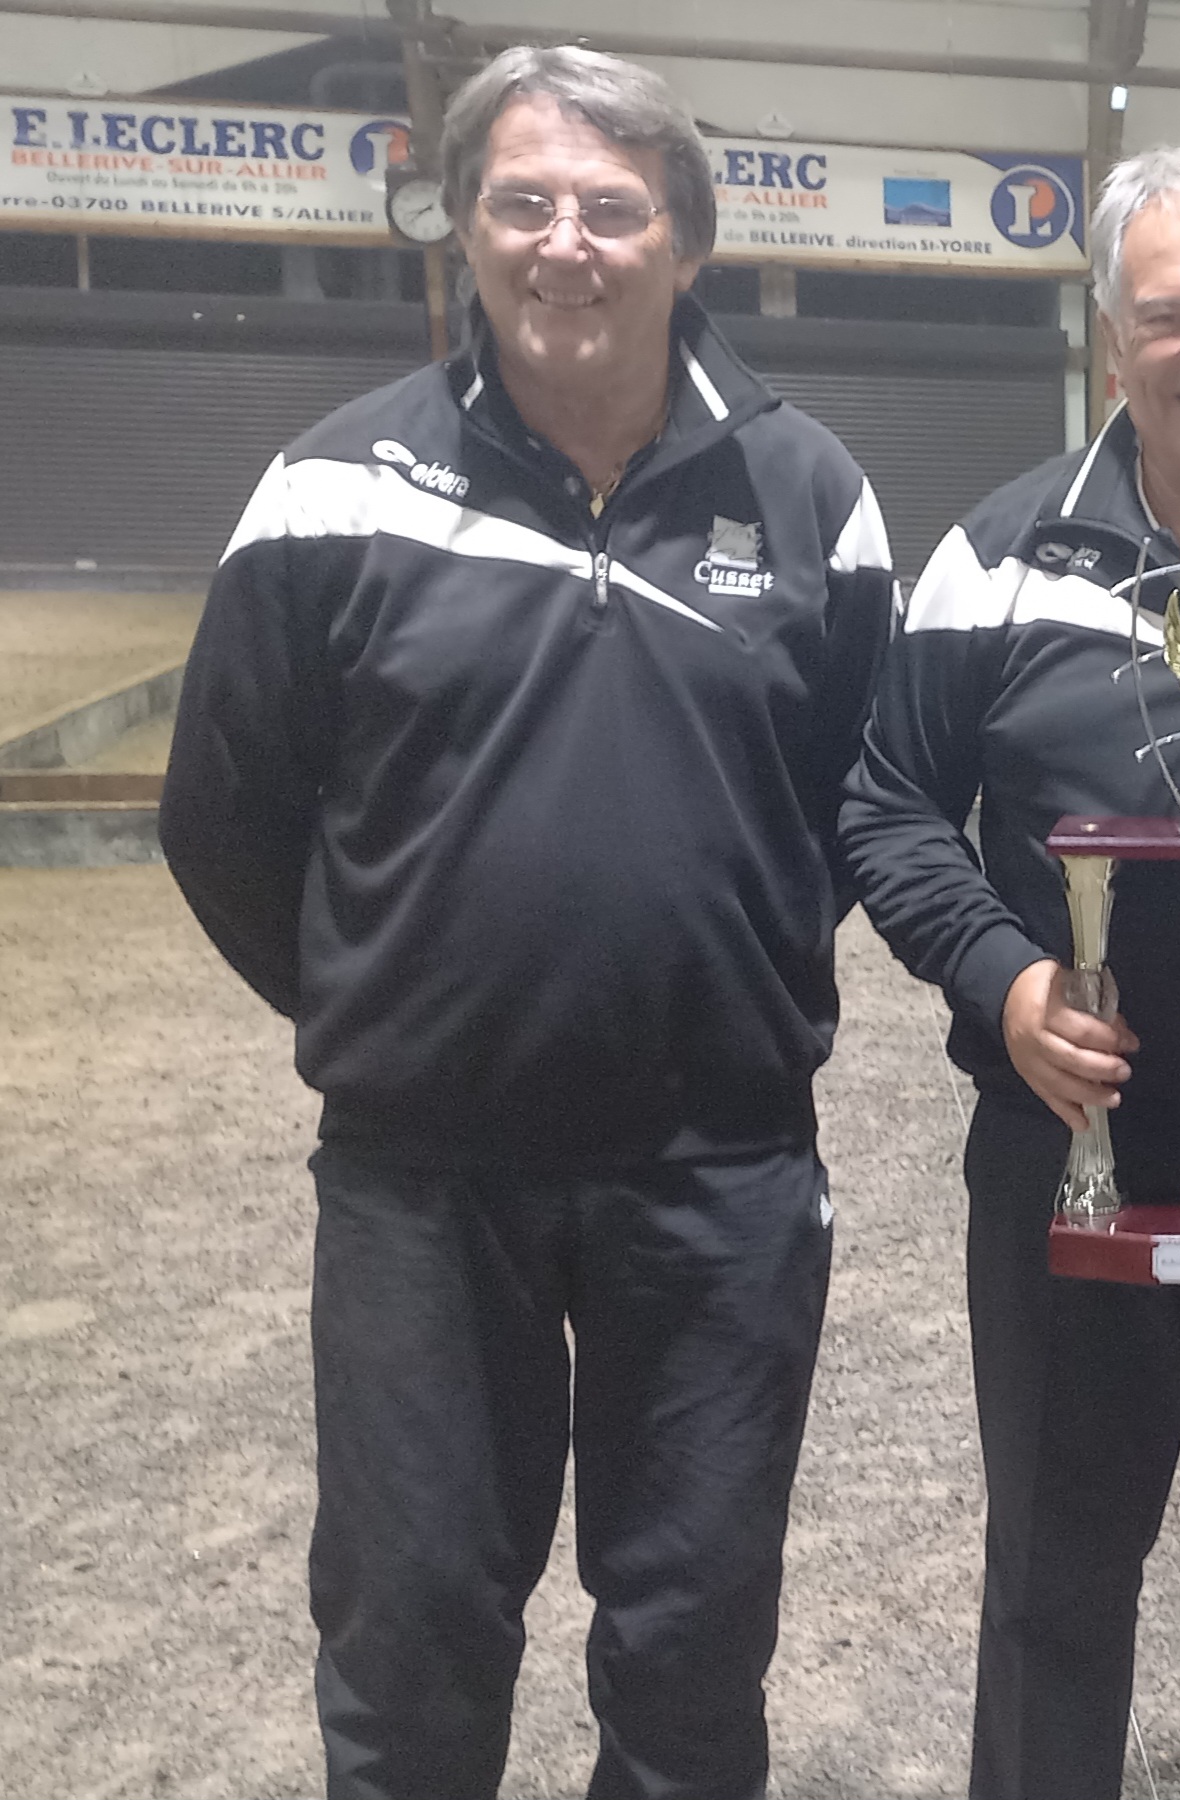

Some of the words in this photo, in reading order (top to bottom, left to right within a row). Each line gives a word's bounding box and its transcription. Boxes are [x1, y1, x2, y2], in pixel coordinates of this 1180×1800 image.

[714, 149, 828, 191] ERC
[141, 199, 263, 218] BELLERIVE
[273, 206, 374, 222] S/ALLIER
[846, 236, 917, 250] direction
[920, 239, 992, 254] St-YORRE
[694, 561, 775, 590] Cusset
